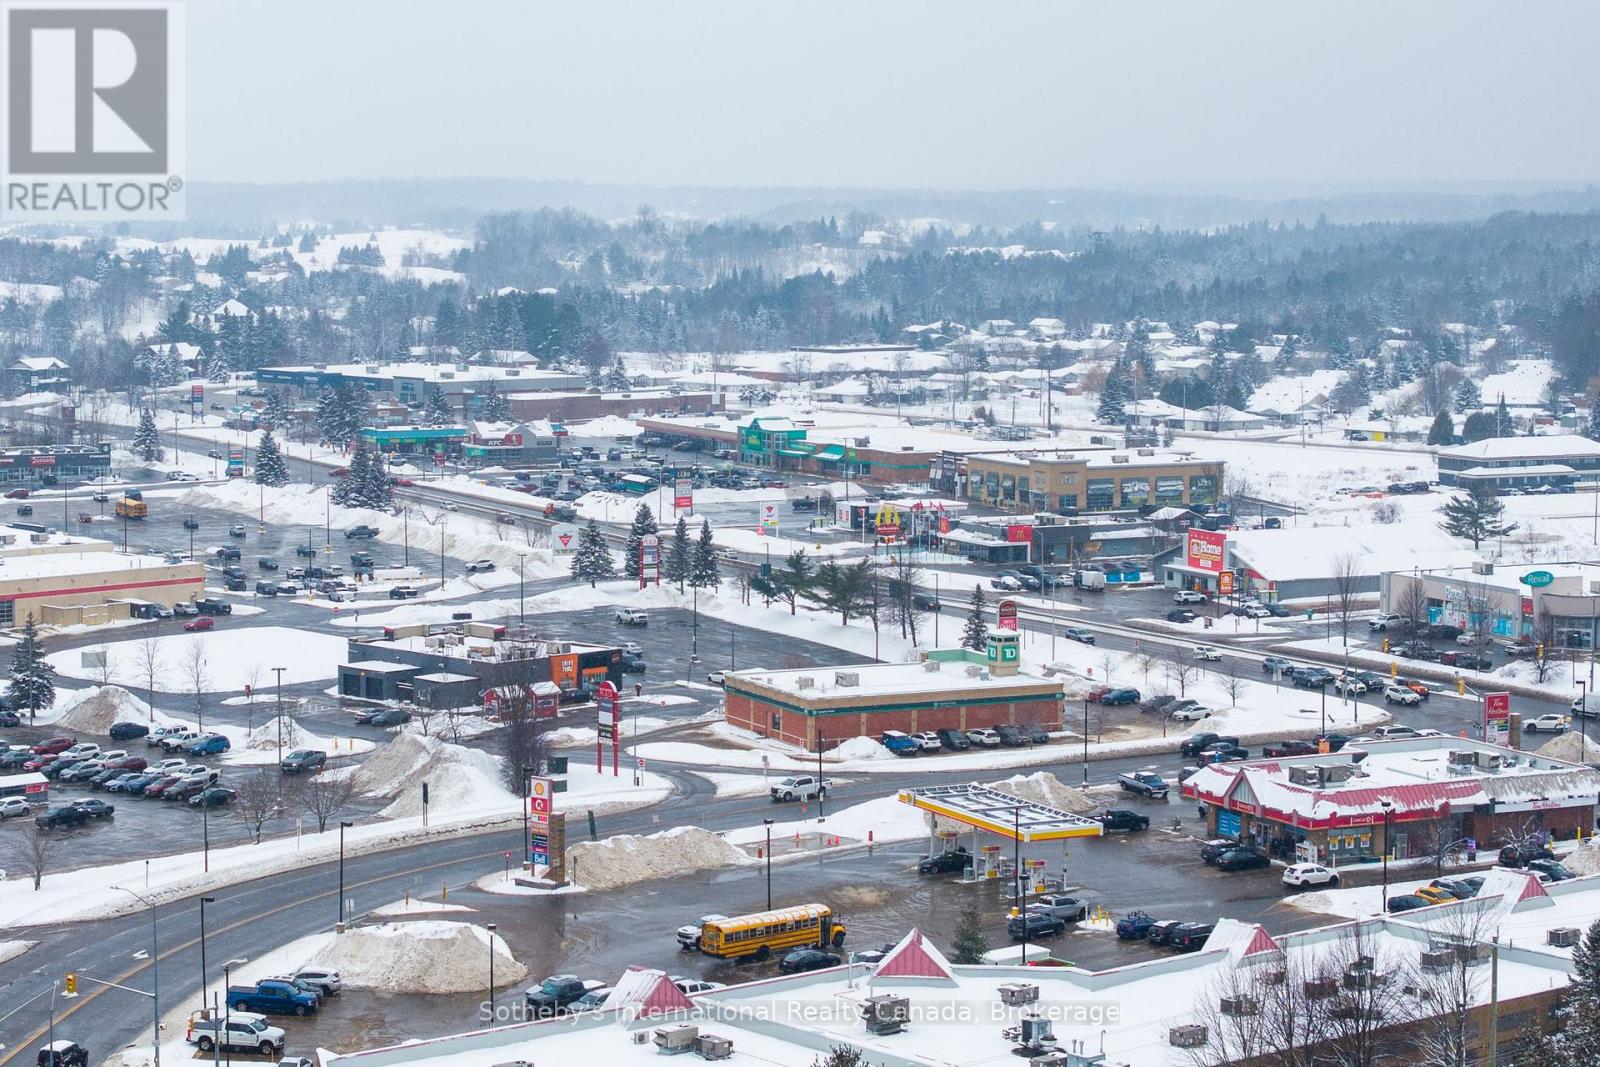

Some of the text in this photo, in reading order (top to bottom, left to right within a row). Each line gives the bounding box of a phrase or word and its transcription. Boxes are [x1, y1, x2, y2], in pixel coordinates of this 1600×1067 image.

[1200, 540, 1222, 556] Home
[1528, 574, 1550, 584] Rexall
[1003, 648, 1016, 659] TD
[1493, 697, 1504, 706] Tim
[534, 853, 546, 864] Bell
